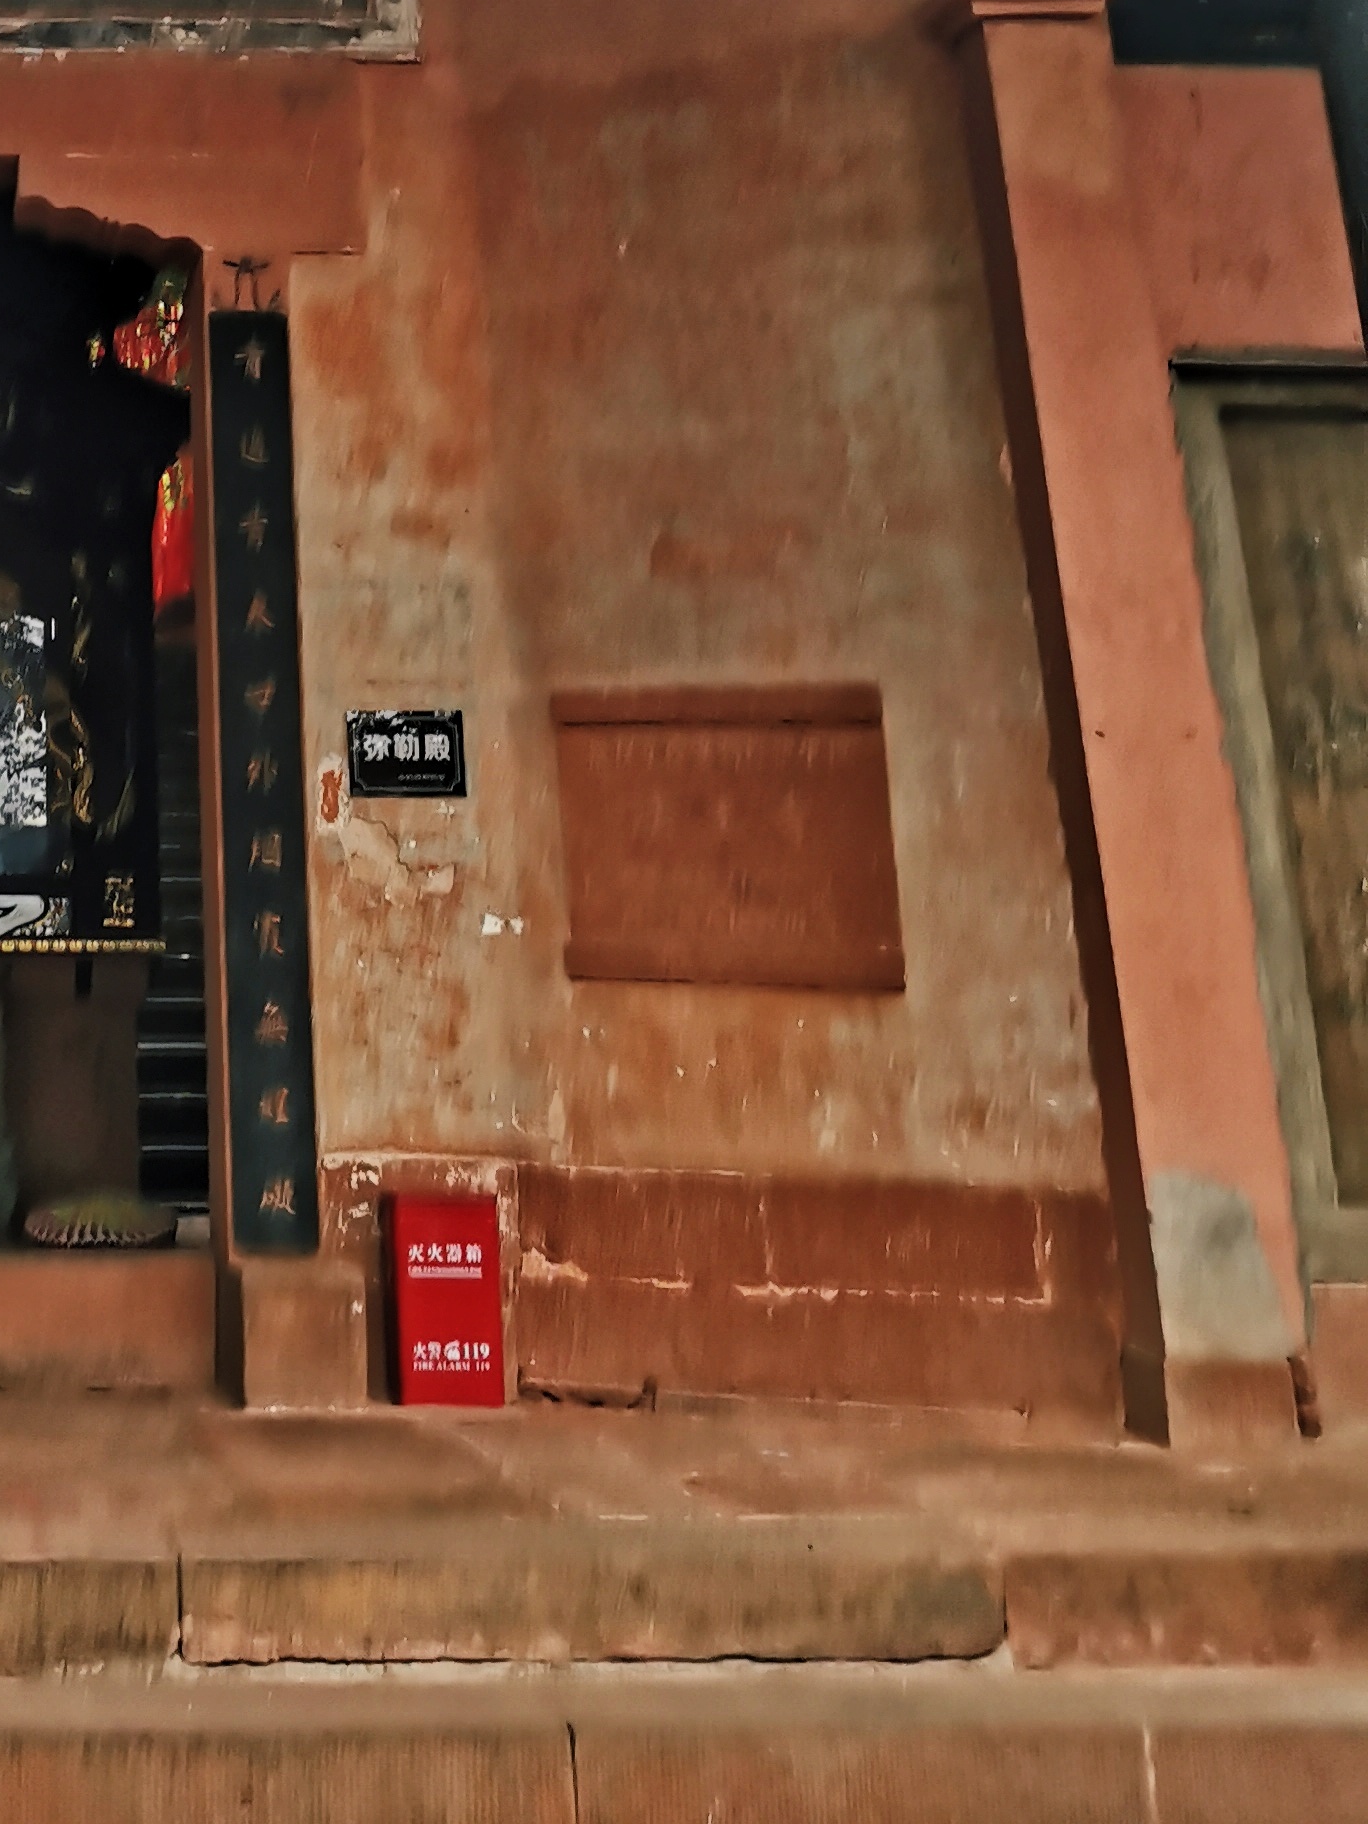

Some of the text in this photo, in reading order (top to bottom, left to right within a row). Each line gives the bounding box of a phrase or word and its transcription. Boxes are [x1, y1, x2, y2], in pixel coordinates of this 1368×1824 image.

[363, 731, 451, 762] 弥勒殿
[408, 1242, 483, 1264] 灭火器箱
[463, 1341, 490, 1361] 119
